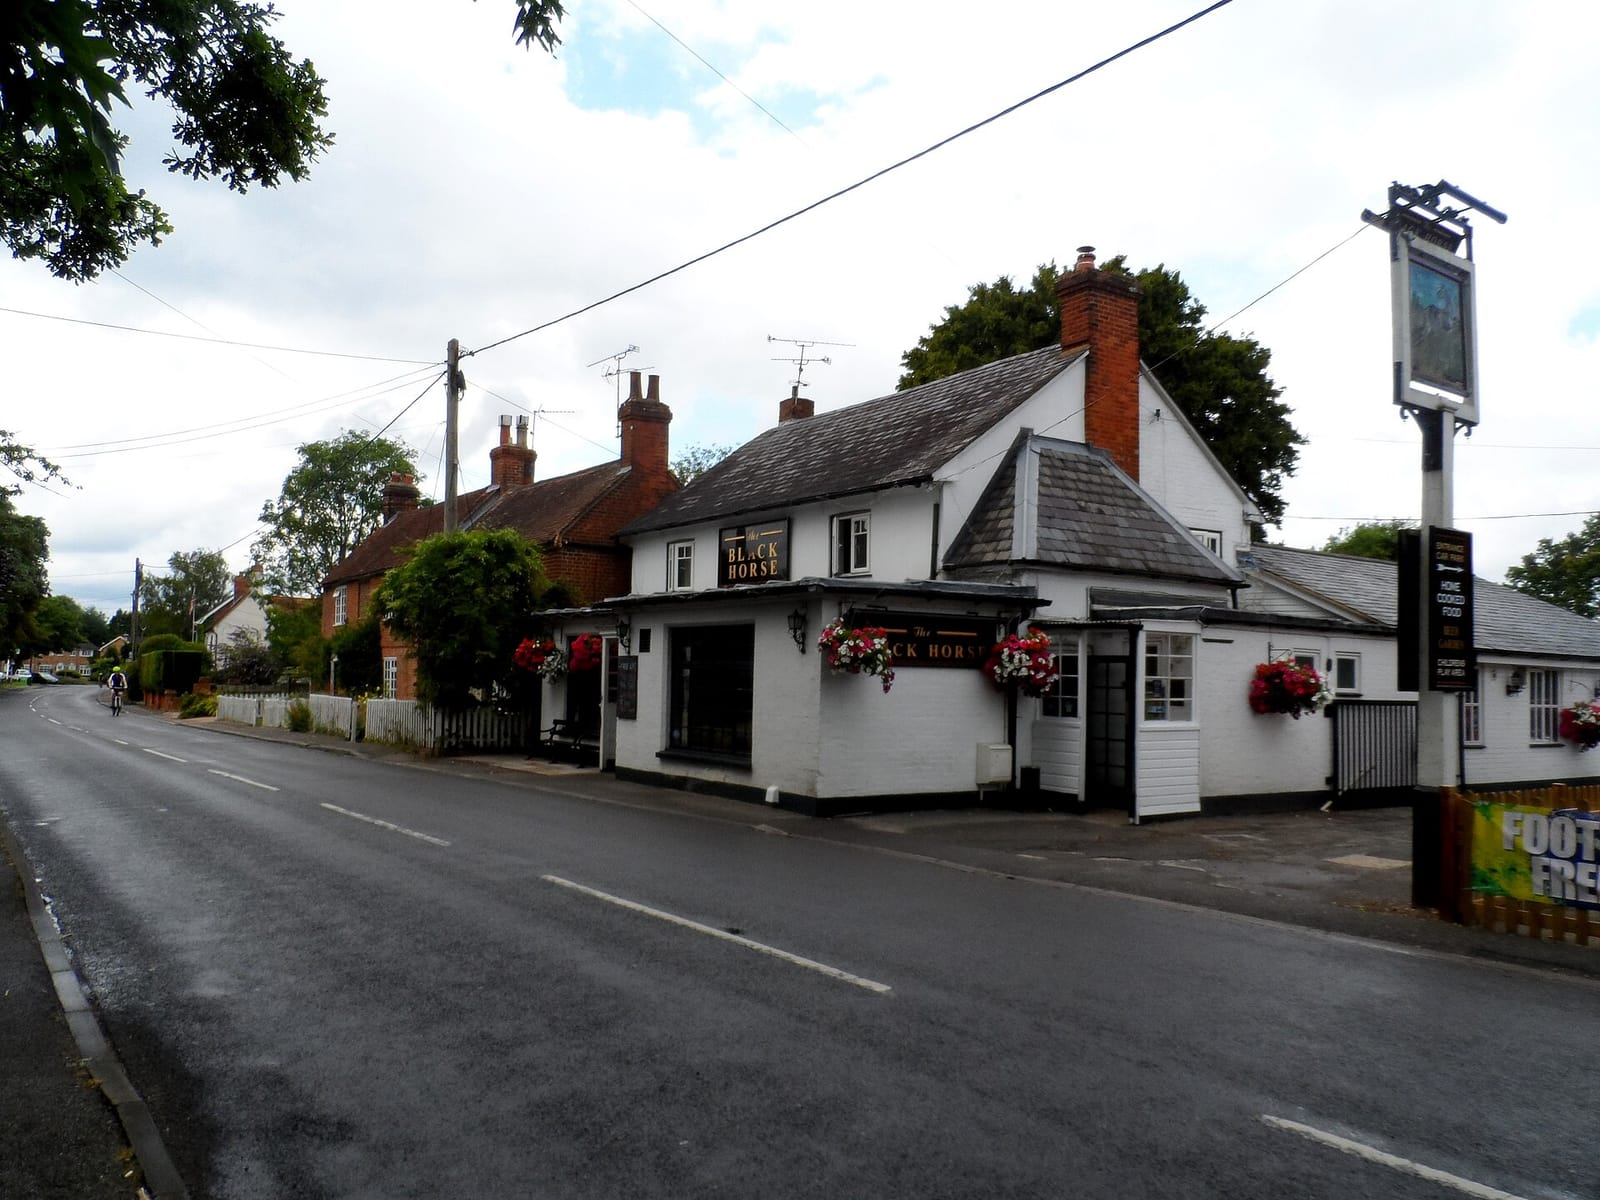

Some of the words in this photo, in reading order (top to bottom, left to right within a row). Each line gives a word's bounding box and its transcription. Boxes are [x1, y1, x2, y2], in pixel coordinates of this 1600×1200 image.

[728, 542, 778, 563] BLACK
[728, 559, 778, 579] HORSE
[1440, 581, 1461, 592] HOME
[1436, 593, 1466, 605] COOKED
[1442, 606, 1462, 618] FOOD
[913, 626, 931, 638] The
[1531, 856, 1600, 904] FRE
